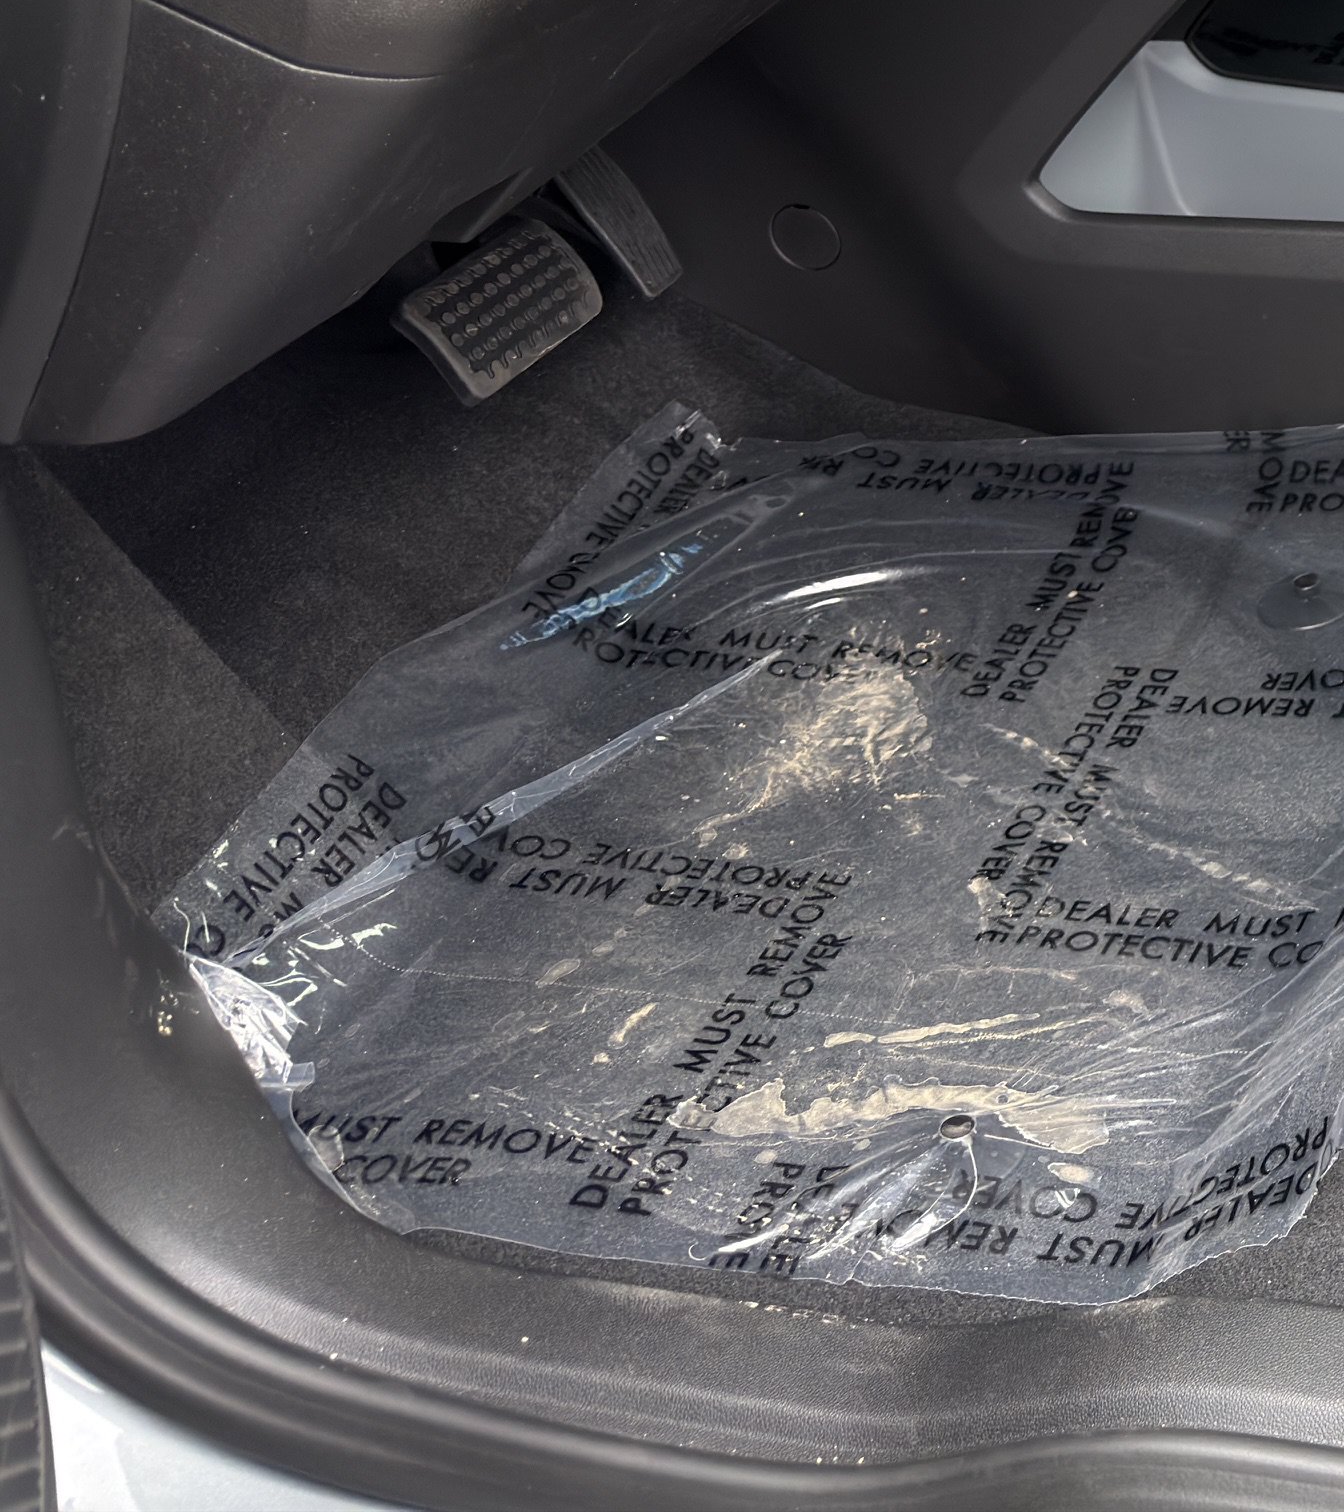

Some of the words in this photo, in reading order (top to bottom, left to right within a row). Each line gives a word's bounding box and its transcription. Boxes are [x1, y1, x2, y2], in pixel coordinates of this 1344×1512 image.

[961, 622, 1037, 698] DEALER
[1026, 549, 1079, 612] MUST
[999, 580, 1104, 704] PROTECTIVE
[1105, 667, 1179, 749] DEALER
[1168, 694, 1314, 718] REMOVE
[222, 754, 376, 923] PROTECTIVE
[312, 781, 407, 888] DEALER
[582, 841, 810, 892] PROTECTIVE
[508, 866, 626, 902] MUST
[644, 883, 792, 921] DEALER
[1035, 895, 1180, 929] DEALER
[1203, 910, 1316, 939] MUST
[765, 933, 854, 1021] COVER
[1015, 925, 1254, 969] PROTECTIVE
[568, 1092, 684, 1211] DEALER
[672, 992, 757, 1074] MUST
[747, 870, 854, 979] REMOVE
[413, 1118, 599, 1165] REMOVE
